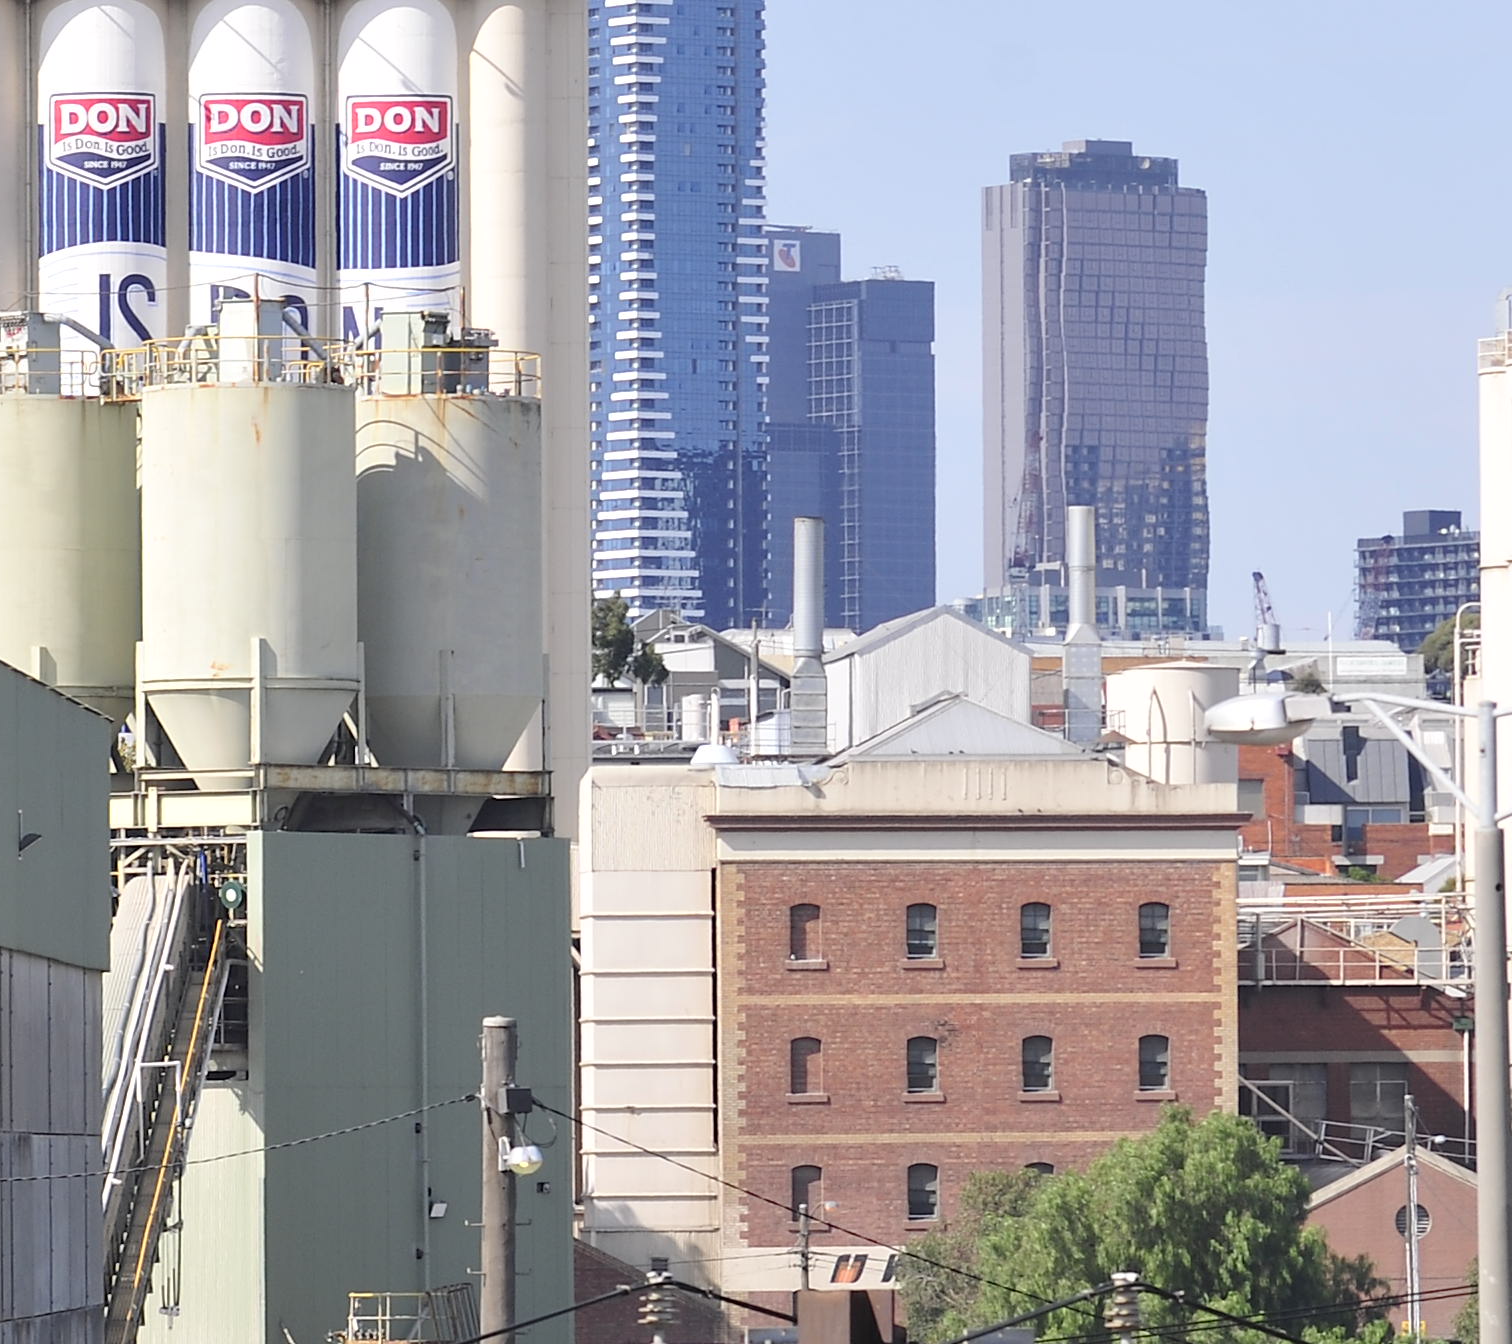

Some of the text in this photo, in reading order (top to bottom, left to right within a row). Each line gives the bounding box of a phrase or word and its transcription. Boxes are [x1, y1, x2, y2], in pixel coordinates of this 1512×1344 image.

[59, 102, 148, 135] DON
[208, 102, 300, 134] DON
[355, 106, 441, 134] DON
[63, 141, 72, 152] Is
[105, 142, 114, 153] Is
[208, 146, 218, 157] Is
[252, 145, 263, 157] Is
[356, 143, 365, 154] Is
[398, 145, 408, 156] Is
[84, 160, 109, 169] SINCE
[229, 161, 257, 170] SINCE
[379, 162, 406, 171] SINCE
